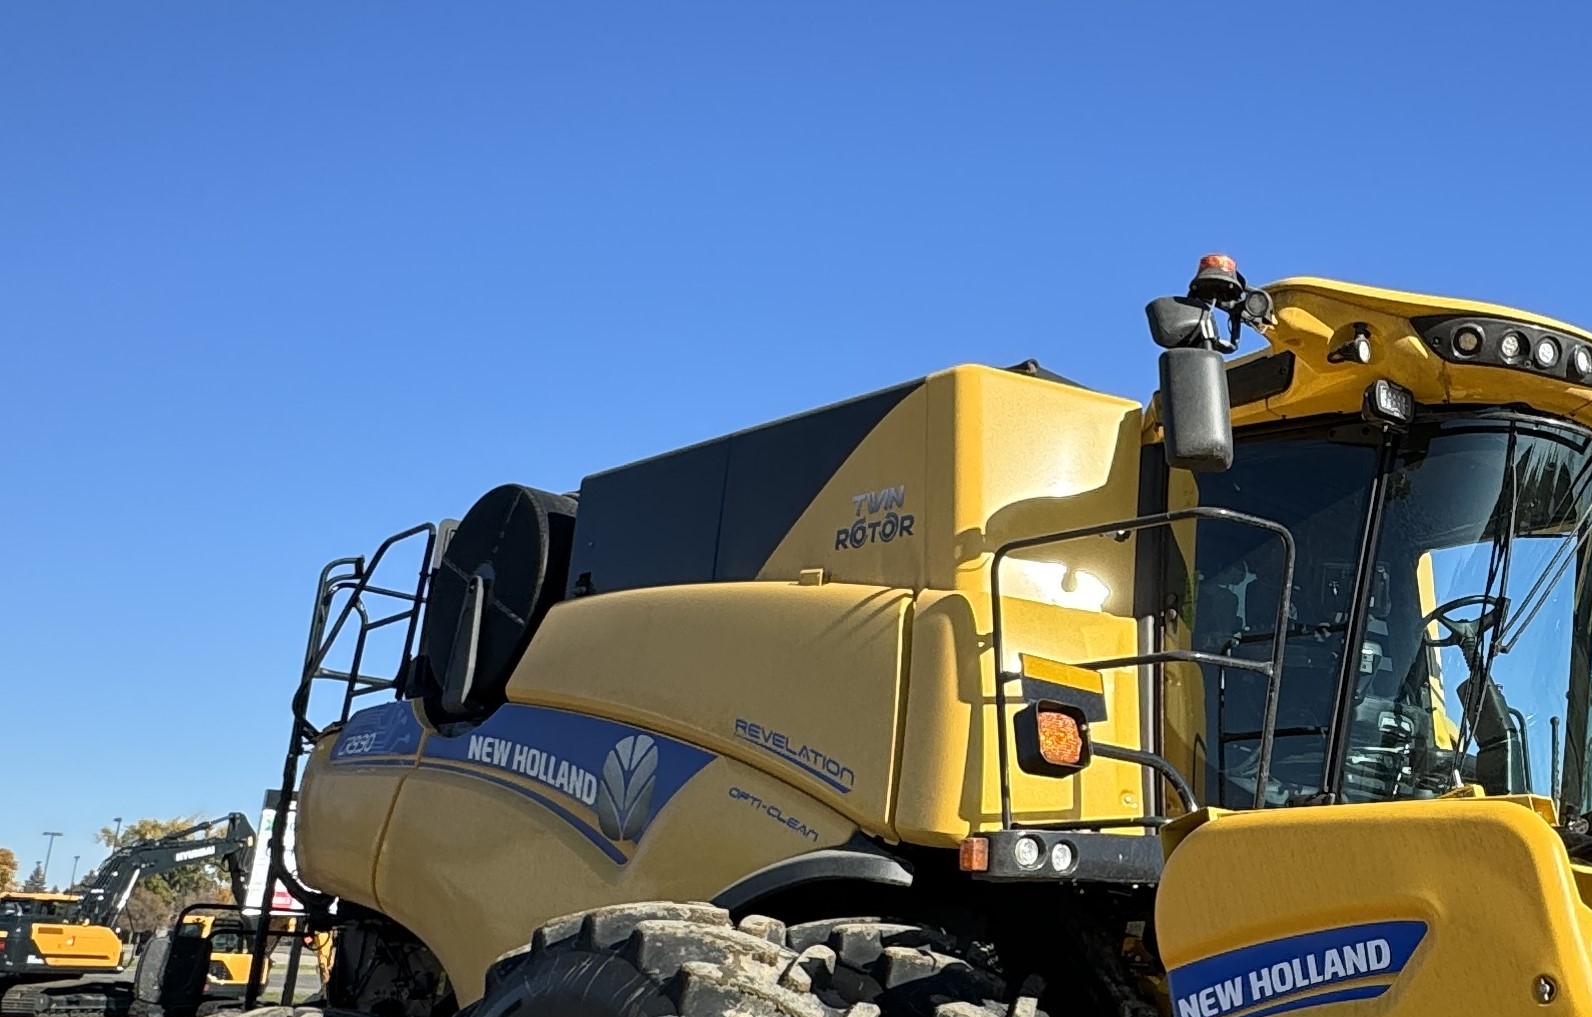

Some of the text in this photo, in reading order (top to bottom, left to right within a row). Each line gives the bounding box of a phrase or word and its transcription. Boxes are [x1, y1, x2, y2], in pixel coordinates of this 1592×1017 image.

[853, 484, 905, 517] TWIN
[835, 511, 915, 551] ROTOR
[467, 734, 598, 806] NEW HOLLAND
[734, 718, 855, 787] REVELATION
[728, 786, 819, 843] OPTI-CLEAN
[1247, 937, 1392, 1001] HOLLAND
